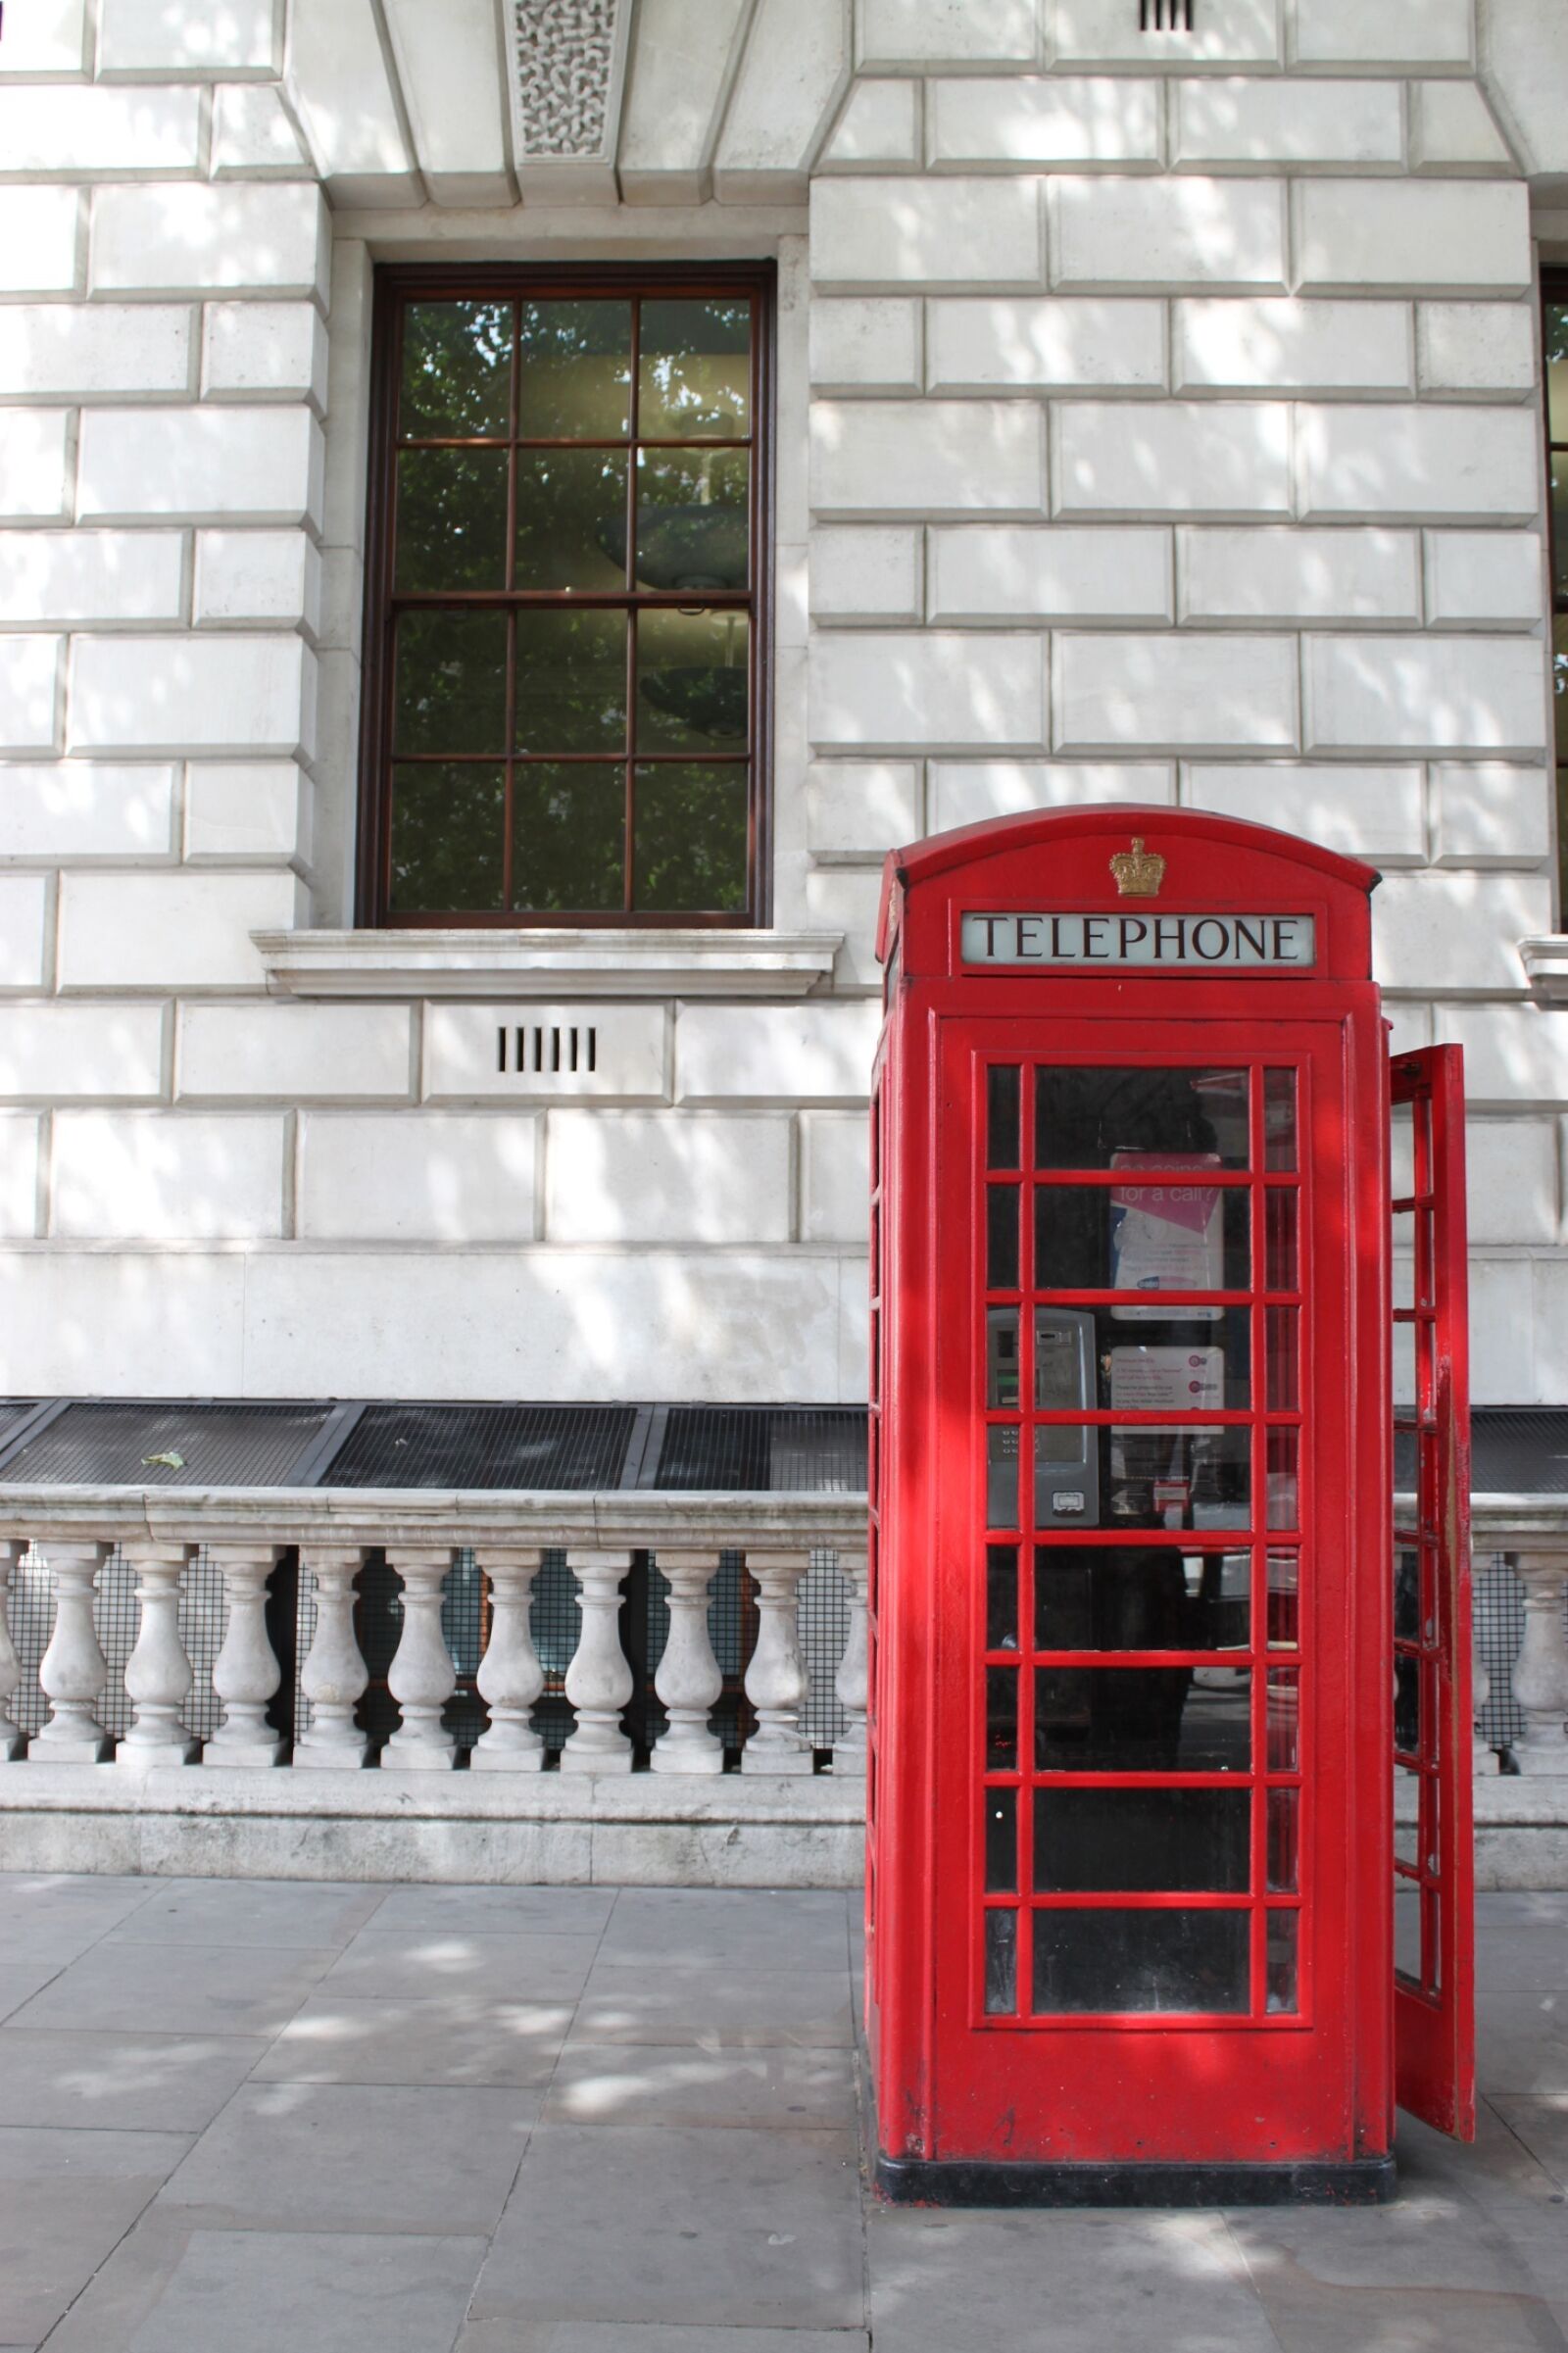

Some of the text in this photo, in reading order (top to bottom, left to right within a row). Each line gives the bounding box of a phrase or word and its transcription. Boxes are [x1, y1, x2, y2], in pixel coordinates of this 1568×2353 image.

[971, 916, 1299, 960] TELEPHONE
[1120, 1186, 1148, 1201] for
[1152, 1186, 1164, 1201] a
